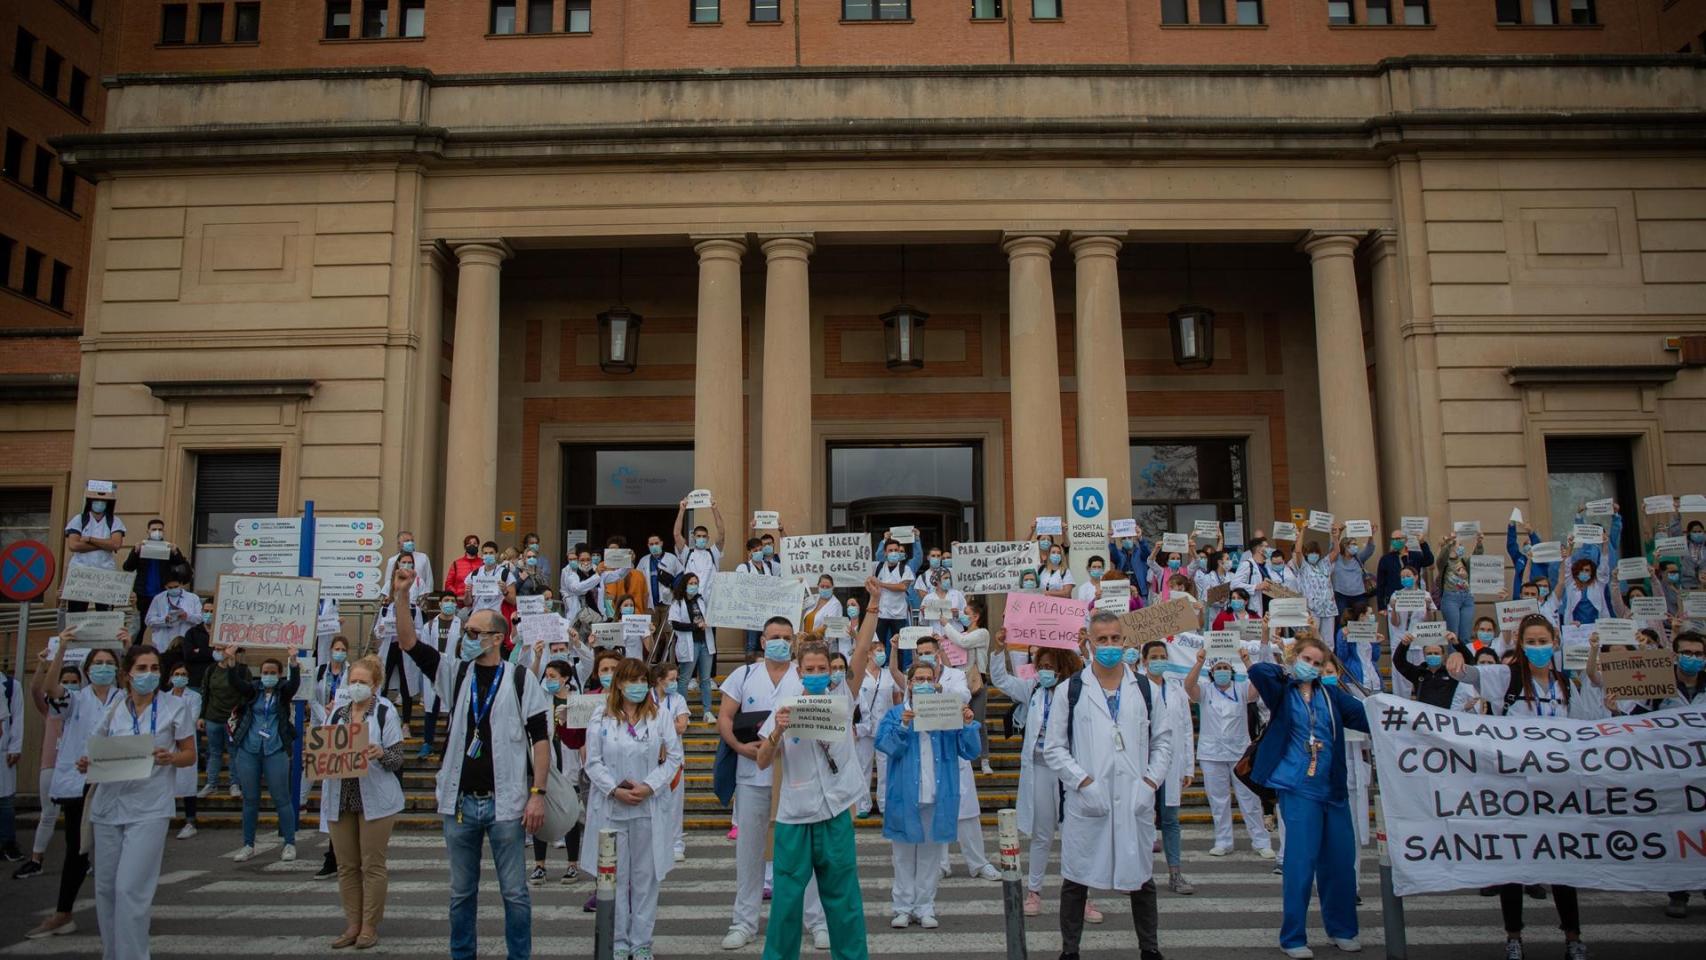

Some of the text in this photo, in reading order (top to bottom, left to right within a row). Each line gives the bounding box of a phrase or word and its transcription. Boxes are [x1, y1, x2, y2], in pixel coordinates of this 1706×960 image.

[1076, 495, 1100, 511] 1A
[958, 544, 979, 555] PARA
[970, 556, 1033, 567] CON CALIDAD
[226, 581, 304, 597] TU MALA
[223, 599, 305, 615] PREVISIÓN MI
[1029, 601, 1086, 617] APLAUSOS
[1013, 628, 1080, 643] DERECHOS
[1602, 658, 1672, 671] INTERINATGES
[816, 724, 846, 732] TRABAJO
[309, 723, 362, 750] STOP
[304, 749, 369, 778] RECORTES
[1398, 747, 1479, 774] CON
[1497, 749, 1572, 774] LAS
[1434, 787, 1658, 817] LABORALES
[1403, 830, 1668, 861] SANITARI@S
